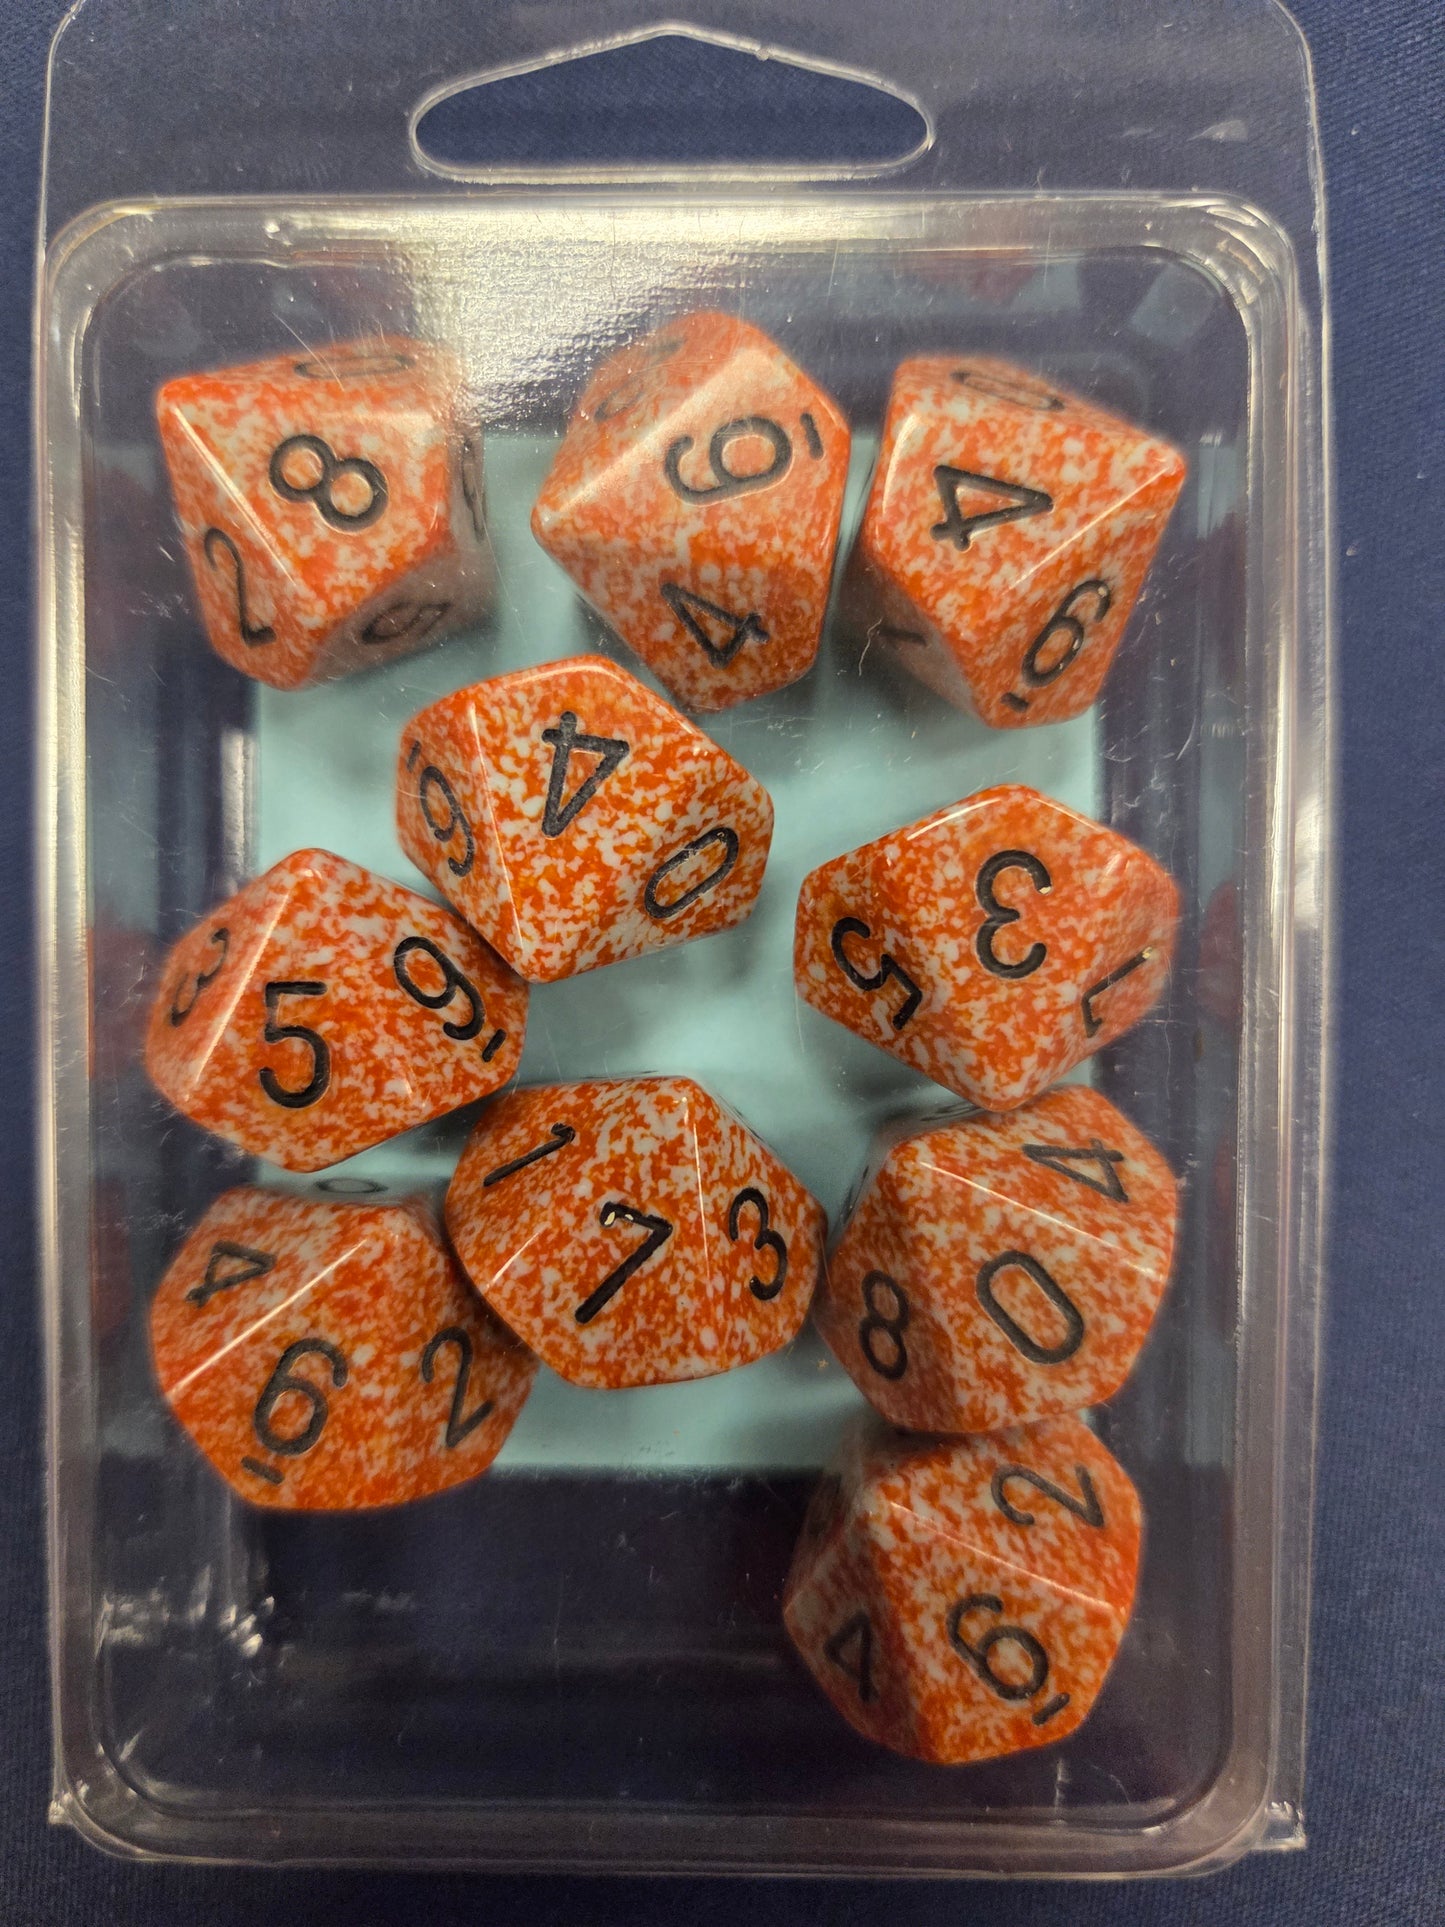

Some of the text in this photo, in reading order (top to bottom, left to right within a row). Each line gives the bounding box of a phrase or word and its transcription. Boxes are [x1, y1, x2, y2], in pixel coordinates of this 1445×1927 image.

[268, 434, 389, 532] 8
[664, 412, 824, 504] 6
[930, 464, 1053, 552] 4
[204, 527, 277, 646] 2
[660, 581, 770, 669] 4
[1001, 579, 1112, 713] 6
[541, 711, 630, 838] 4
[645, 826, 739, 919] 0
[975, 849, 1053, 980] 3
[394, 936, 506, 1062] 9
[831, 916, 923, 1030] 5
[1081, 946, 1154, 1038] 7
[259, 981, 331, 1108] 5
[483, 1122, 576, 1187] 1
[1022, 1138, 1129, 1202] 4
[185, 1240, 277, 1308] 4
[574, 1201, 673, 1324] 7
[729, 1187, 788, 1300] 3
[859, 1270, 910, 1381] 8
[975, 1251, 1084, 1365] 0
[241, 1338, 348, 1484] 6
[422, 1326, 495, 1449] 2
[991, 1463, 1105, 1528] 2
[823, 1610, 880, 1703] 4
[947, 1593, 1071, 1726] 6
